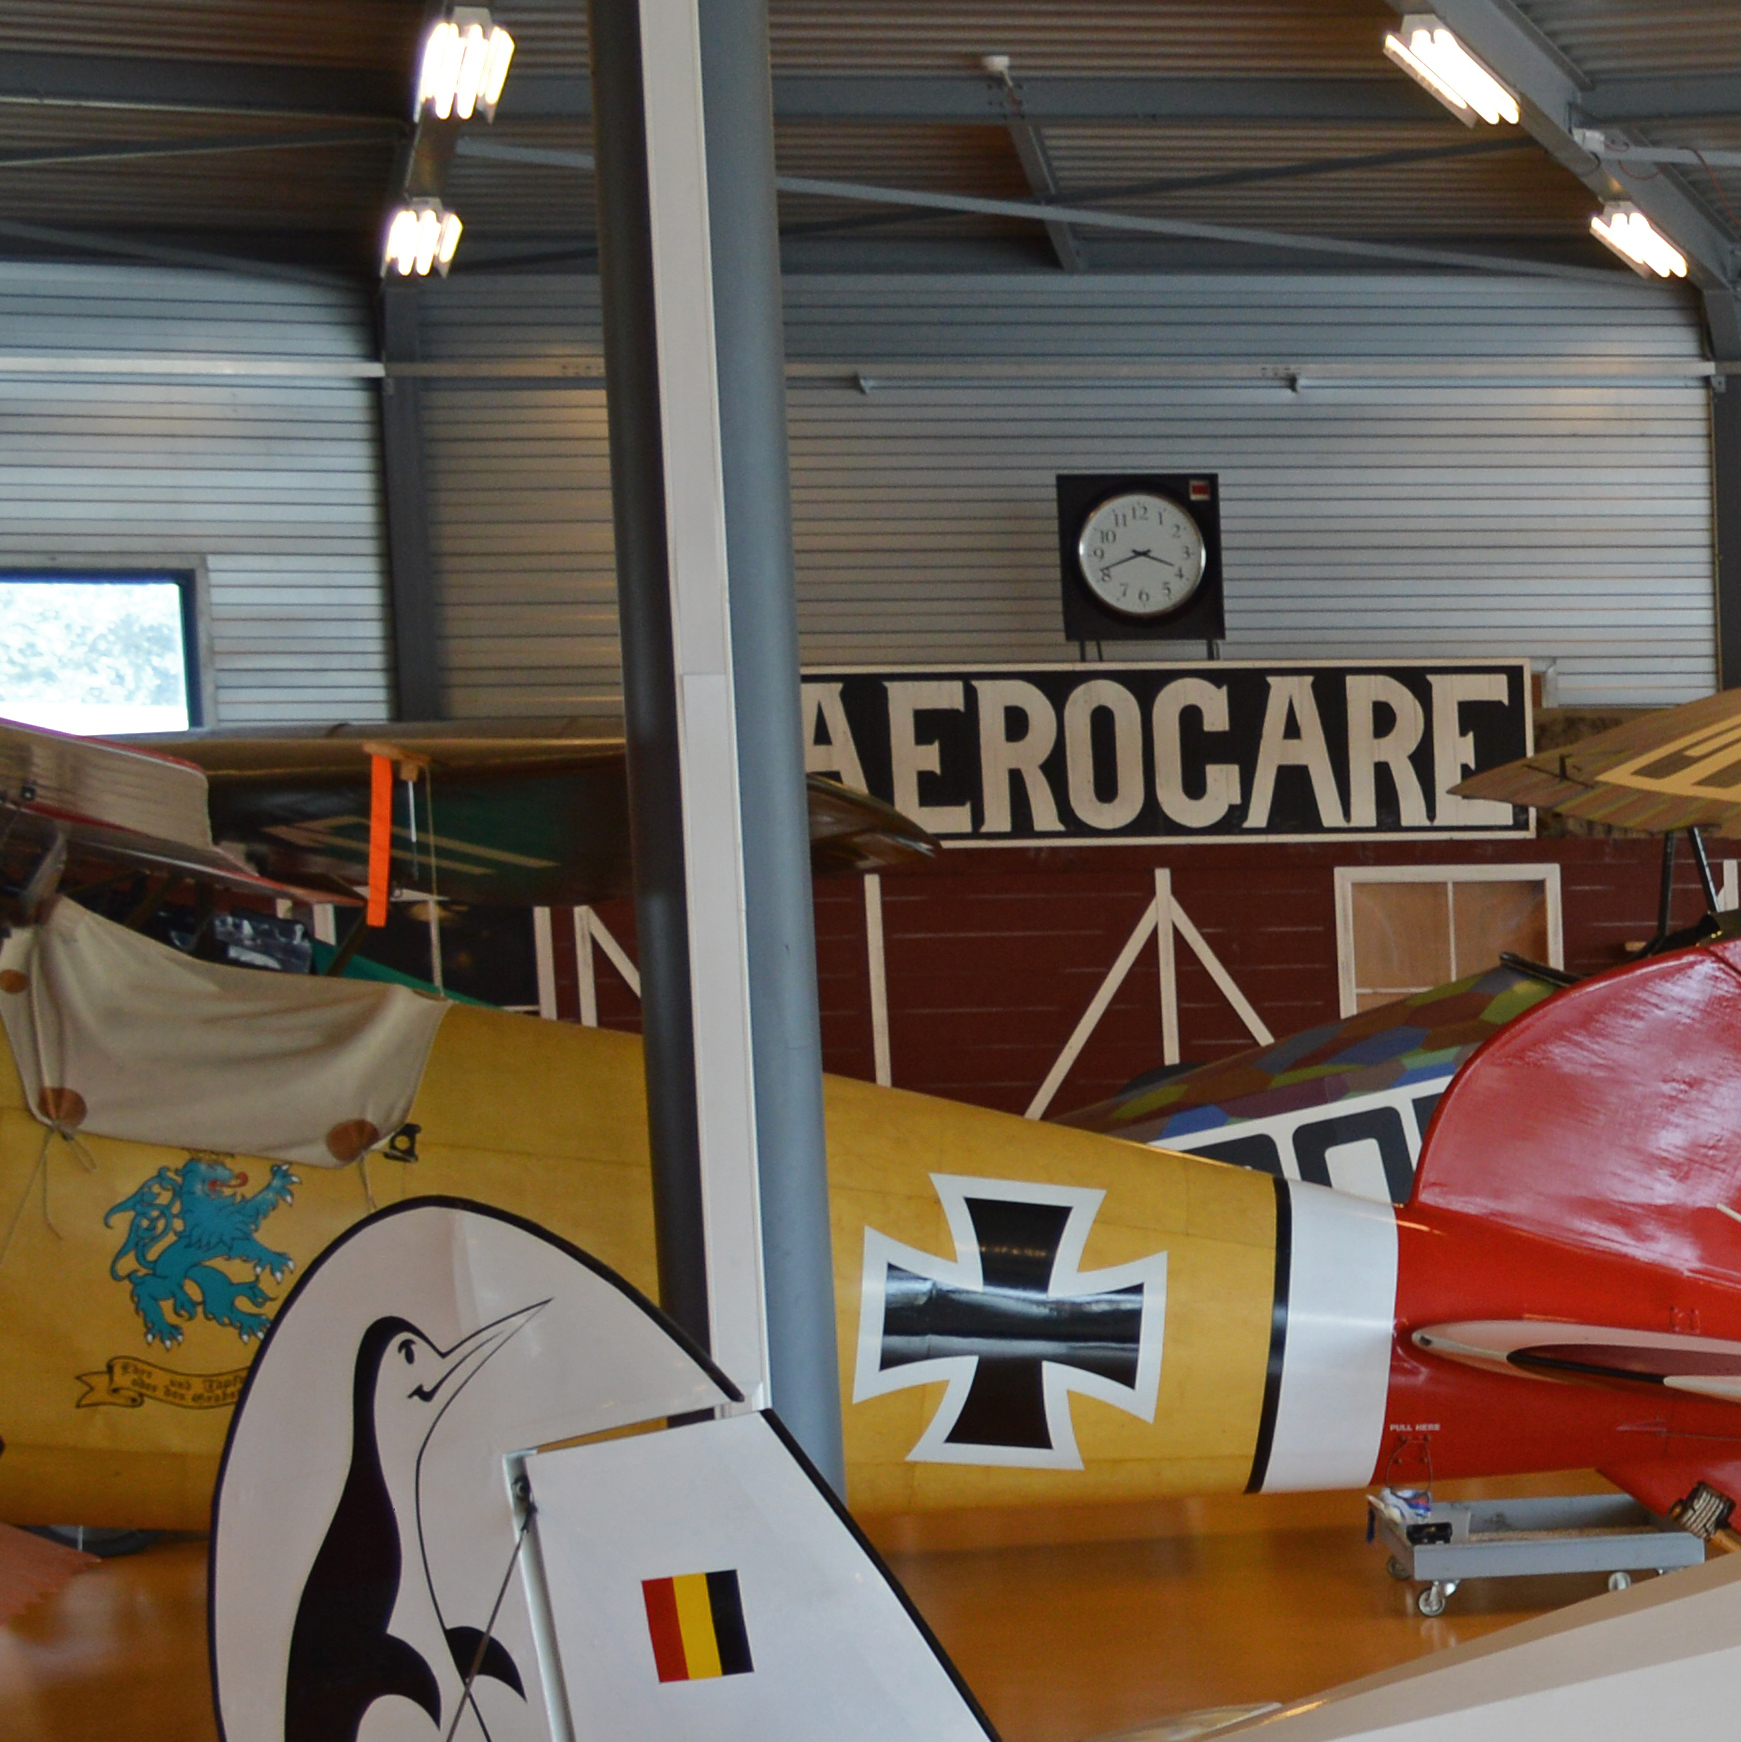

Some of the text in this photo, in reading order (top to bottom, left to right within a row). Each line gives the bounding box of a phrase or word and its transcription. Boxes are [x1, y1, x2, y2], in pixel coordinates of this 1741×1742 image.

[1113, 513, 1128, 528] 11
[1131, 505, 1148, 521] 12
[1099, 530, 1116, 544] 10
[1172, 525, 1181, 539] 2
[1093, 549, 1104, 560] 9
[1182, 545, 1191, 560] 3
[1100, 568, 1111, 583] 8
[1174, 566, 1184, 581] 4
[1119, 583, 1129, 598] 7
[1138, 589, 1149, 602] 6
[1162, 582, 1171, 596] 5
[801, 673, 1514, 833] AEROCARE
[1389, 1423, 1441, 1432] PULL HERE
